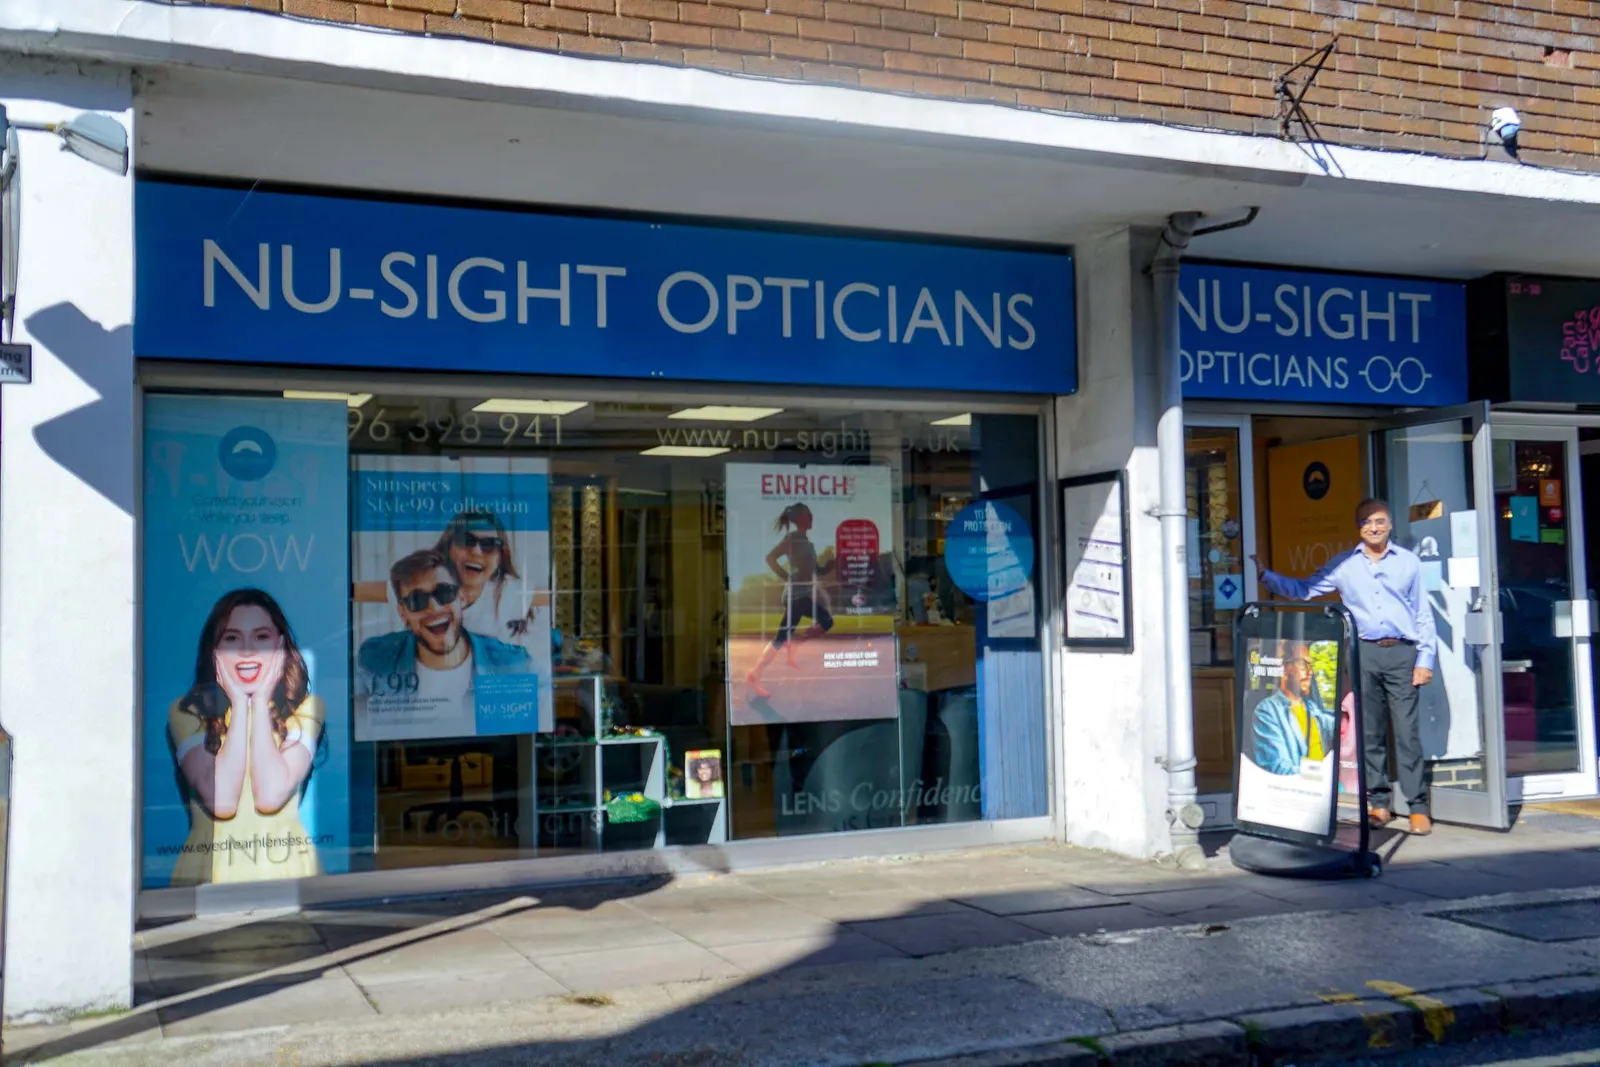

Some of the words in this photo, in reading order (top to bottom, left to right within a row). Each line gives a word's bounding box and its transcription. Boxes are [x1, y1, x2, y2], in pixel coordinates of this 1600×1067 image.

[203, 238, 626, 328] NU-SIGHT
[657, 271, 1036, 351] OPTICIANS
[1178, 278, 1432, 343] NU-SIGHT
[1180, 349, 1350, 390] OPTICIANS
[408, 411, 482, 444] 398
[499, 413, 564, 445] 941
[656, 421, 961, 458] www.nu-sighto.uk
[366, 478, 451, 494] Sunspecs
[761, 473, 848, 496] ENRICH
[366, 496, 435, 516] Style99
[440, 496, 530, 515] Collection
[178, 533, 315, 573] WOW
[368, 671, 419, 697] £99
[781, 789, 846, 815] LENS
[851, 777, 982, 815] Confidenc
[156, 832, 335, 855] www.eyedreamlenses.com
[441, 809, 604, 844] opticans
